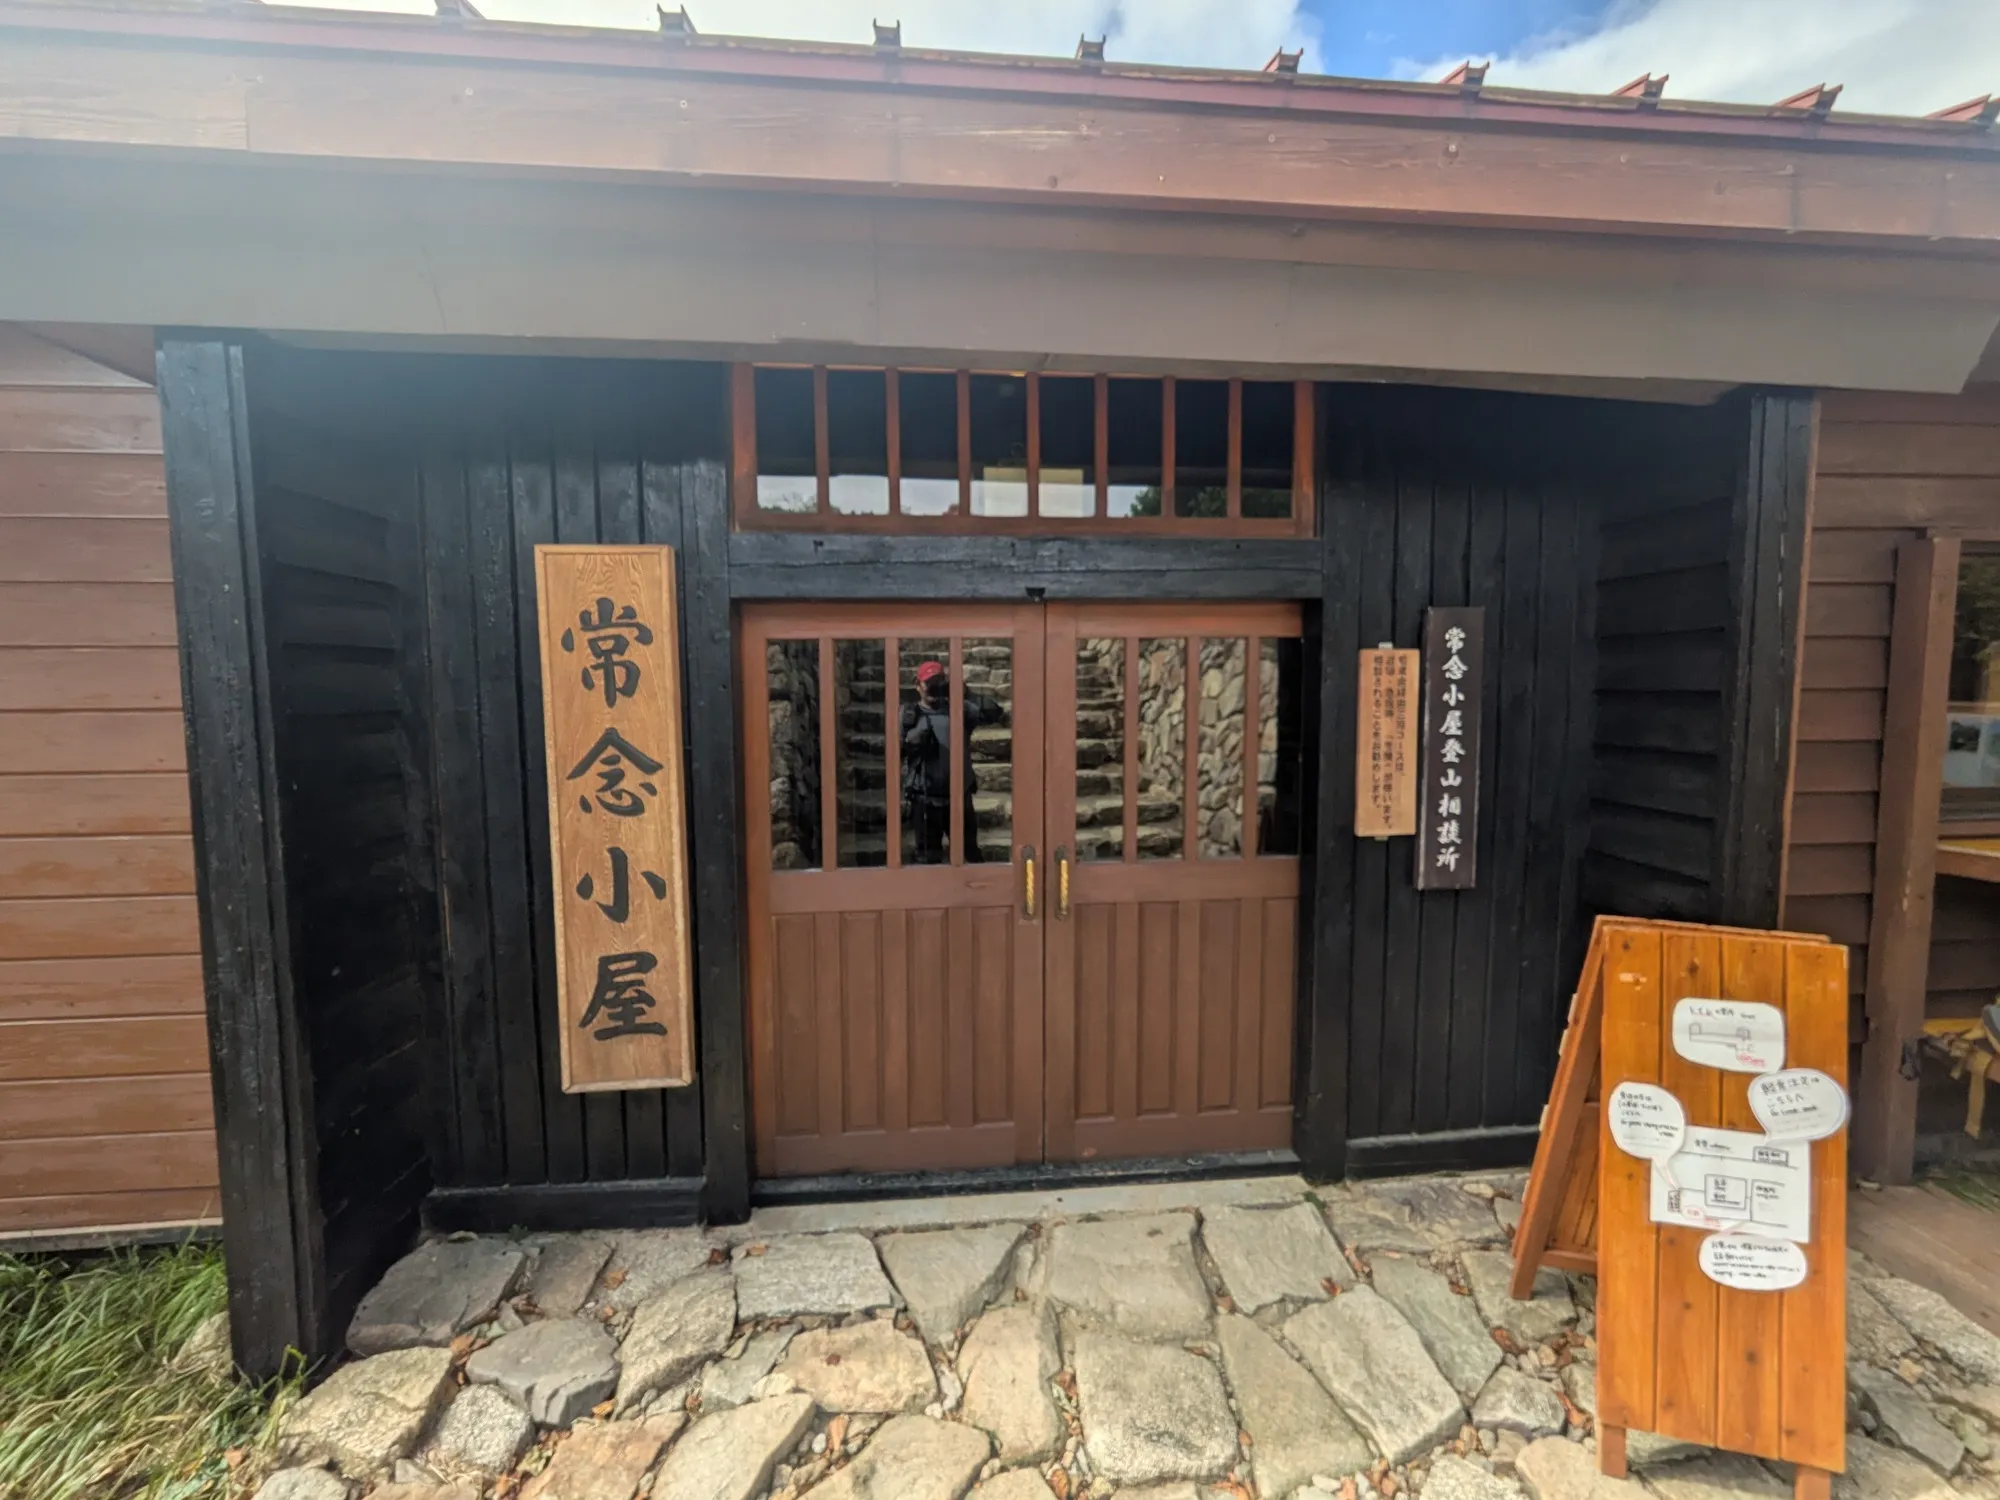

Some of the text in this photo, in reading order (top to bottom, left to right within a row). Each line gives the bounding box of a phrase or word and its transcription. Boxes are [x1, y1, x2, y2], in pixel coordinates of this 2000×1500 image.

[561, 597, 667, 1041] 常念小屋
[1436, 626, 1468, 872] 常念小屋登山相談所
